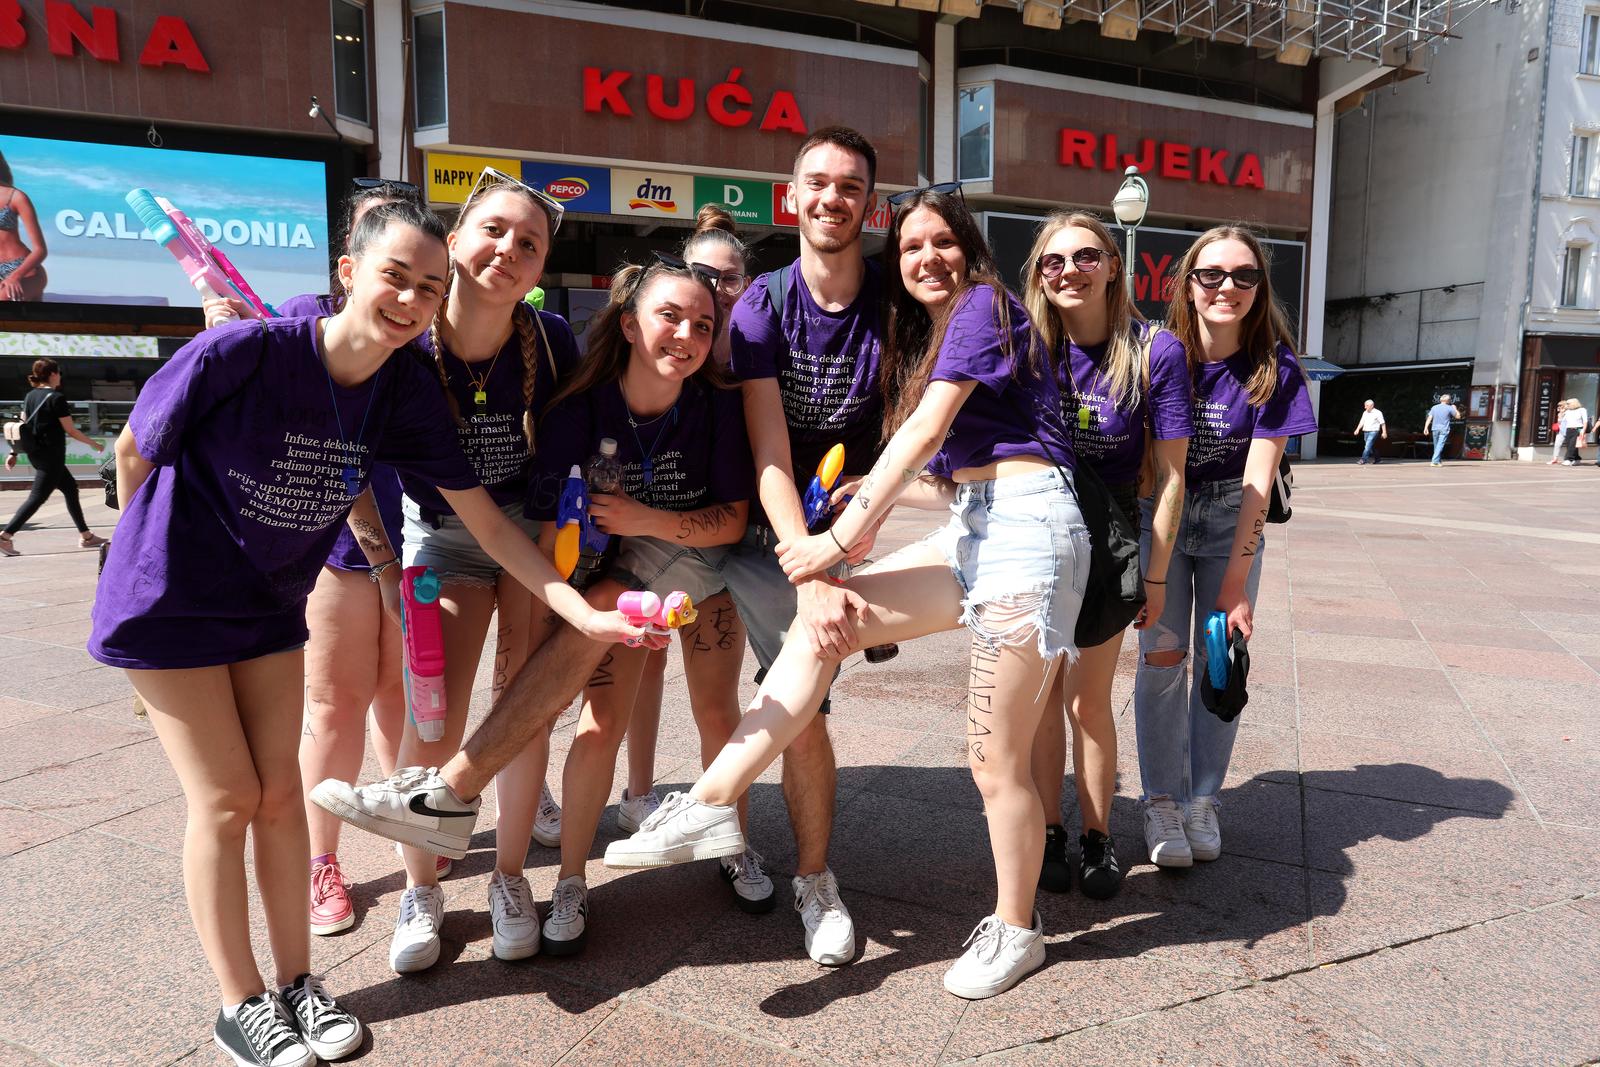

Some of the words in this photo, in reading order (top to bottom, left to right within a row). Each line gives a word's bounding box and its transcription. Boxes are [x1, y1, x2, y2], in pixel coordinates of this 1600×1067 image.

[583, 66, 809, 135] KUĆA
[1058, 128, 1265, 189] RIJEKA
[434, 168, 473, 187] HAPPY
[549, 183, 584, 196] PEPCO
[637, 178, 671, 201] dm
[724, 184, 744, 206] D
[55, 209, 316, 249] CALDONIA
[789, 348, 818, 363] Infuze,
[820, 354, 856, 364] dekokte,
[791, 361, 819, 373] kreme
[821, 365, 824, 373] i
[826, 365, 849, 374] masti
[781, 369, 812, 383] radimo
[814, 376, 857, 386] pripravke
[793, 380, 821, 395] "puno"
[822, 386, 849, 395] strasti
[1195, 402, 1229, 412] dekokte,
[471, 413, 515, 424] dekokte,
[1201, 412, 1223, 420] masti
[474, 425, 478, 434] i
[481, 423, 510, 434] masti
[1075, 430, 1130, 442] ljekarnikom
[284, 432, 321, 448] Infuze,
[323, 438, 370, 454] dekokte,
[468, 434, 522, 446] pripravke
[480, 443, 513, 453] strasti
[1200, 436, 1249, 446] ljekarnikom
[287, 446, 321, 460] kreme
[323, 453, 328, 461] i
[329, 454, 361, 465] masti
[270, 459, 312, 472] radimo
[228, 469, 256, 487] prije
[260, 483, 314, 498] upotrebe
[285, 472, 322, 486] "puno"
[240, 484, 251, 494] se
[254, 490, 319, 511] NEMOJTE
[240, 507, 256, 518] ne
[257, 513, 297, 529] znamo
[249, 500, 296, 520] nažalost
[299, 513, 313, 522] ni
